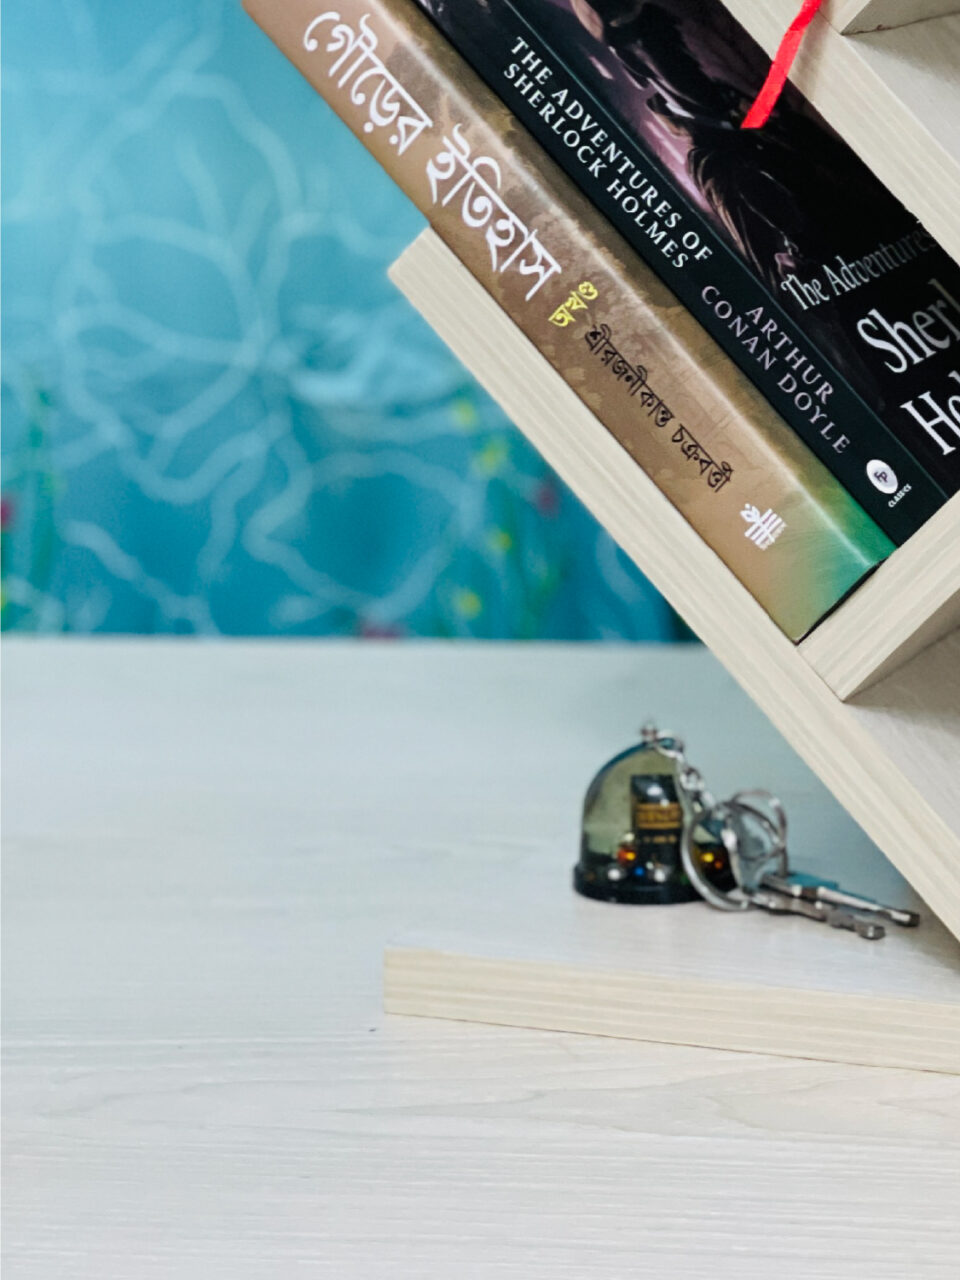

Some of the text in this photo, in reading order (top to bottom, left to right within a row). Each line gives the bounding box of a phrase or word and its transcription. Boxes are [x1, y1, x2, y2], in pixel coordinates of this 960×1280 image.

[303, 10, 562, 301] গৌড়ের ইতিহাস
[503, 62, 690, 269] SHERLOCK HOLMES
[510, 36, 713, 262] THE ADVENTURES OF
[548, 281, 599, 328] অখণ্ড
[745, 305, 835, 406] ARTHUR
[780, 274, 830, 311] The
[584, 323, 675, 429] শ্রীরজনীকান্ত
[701, 285, 851, 454] CONAN DOYLE
